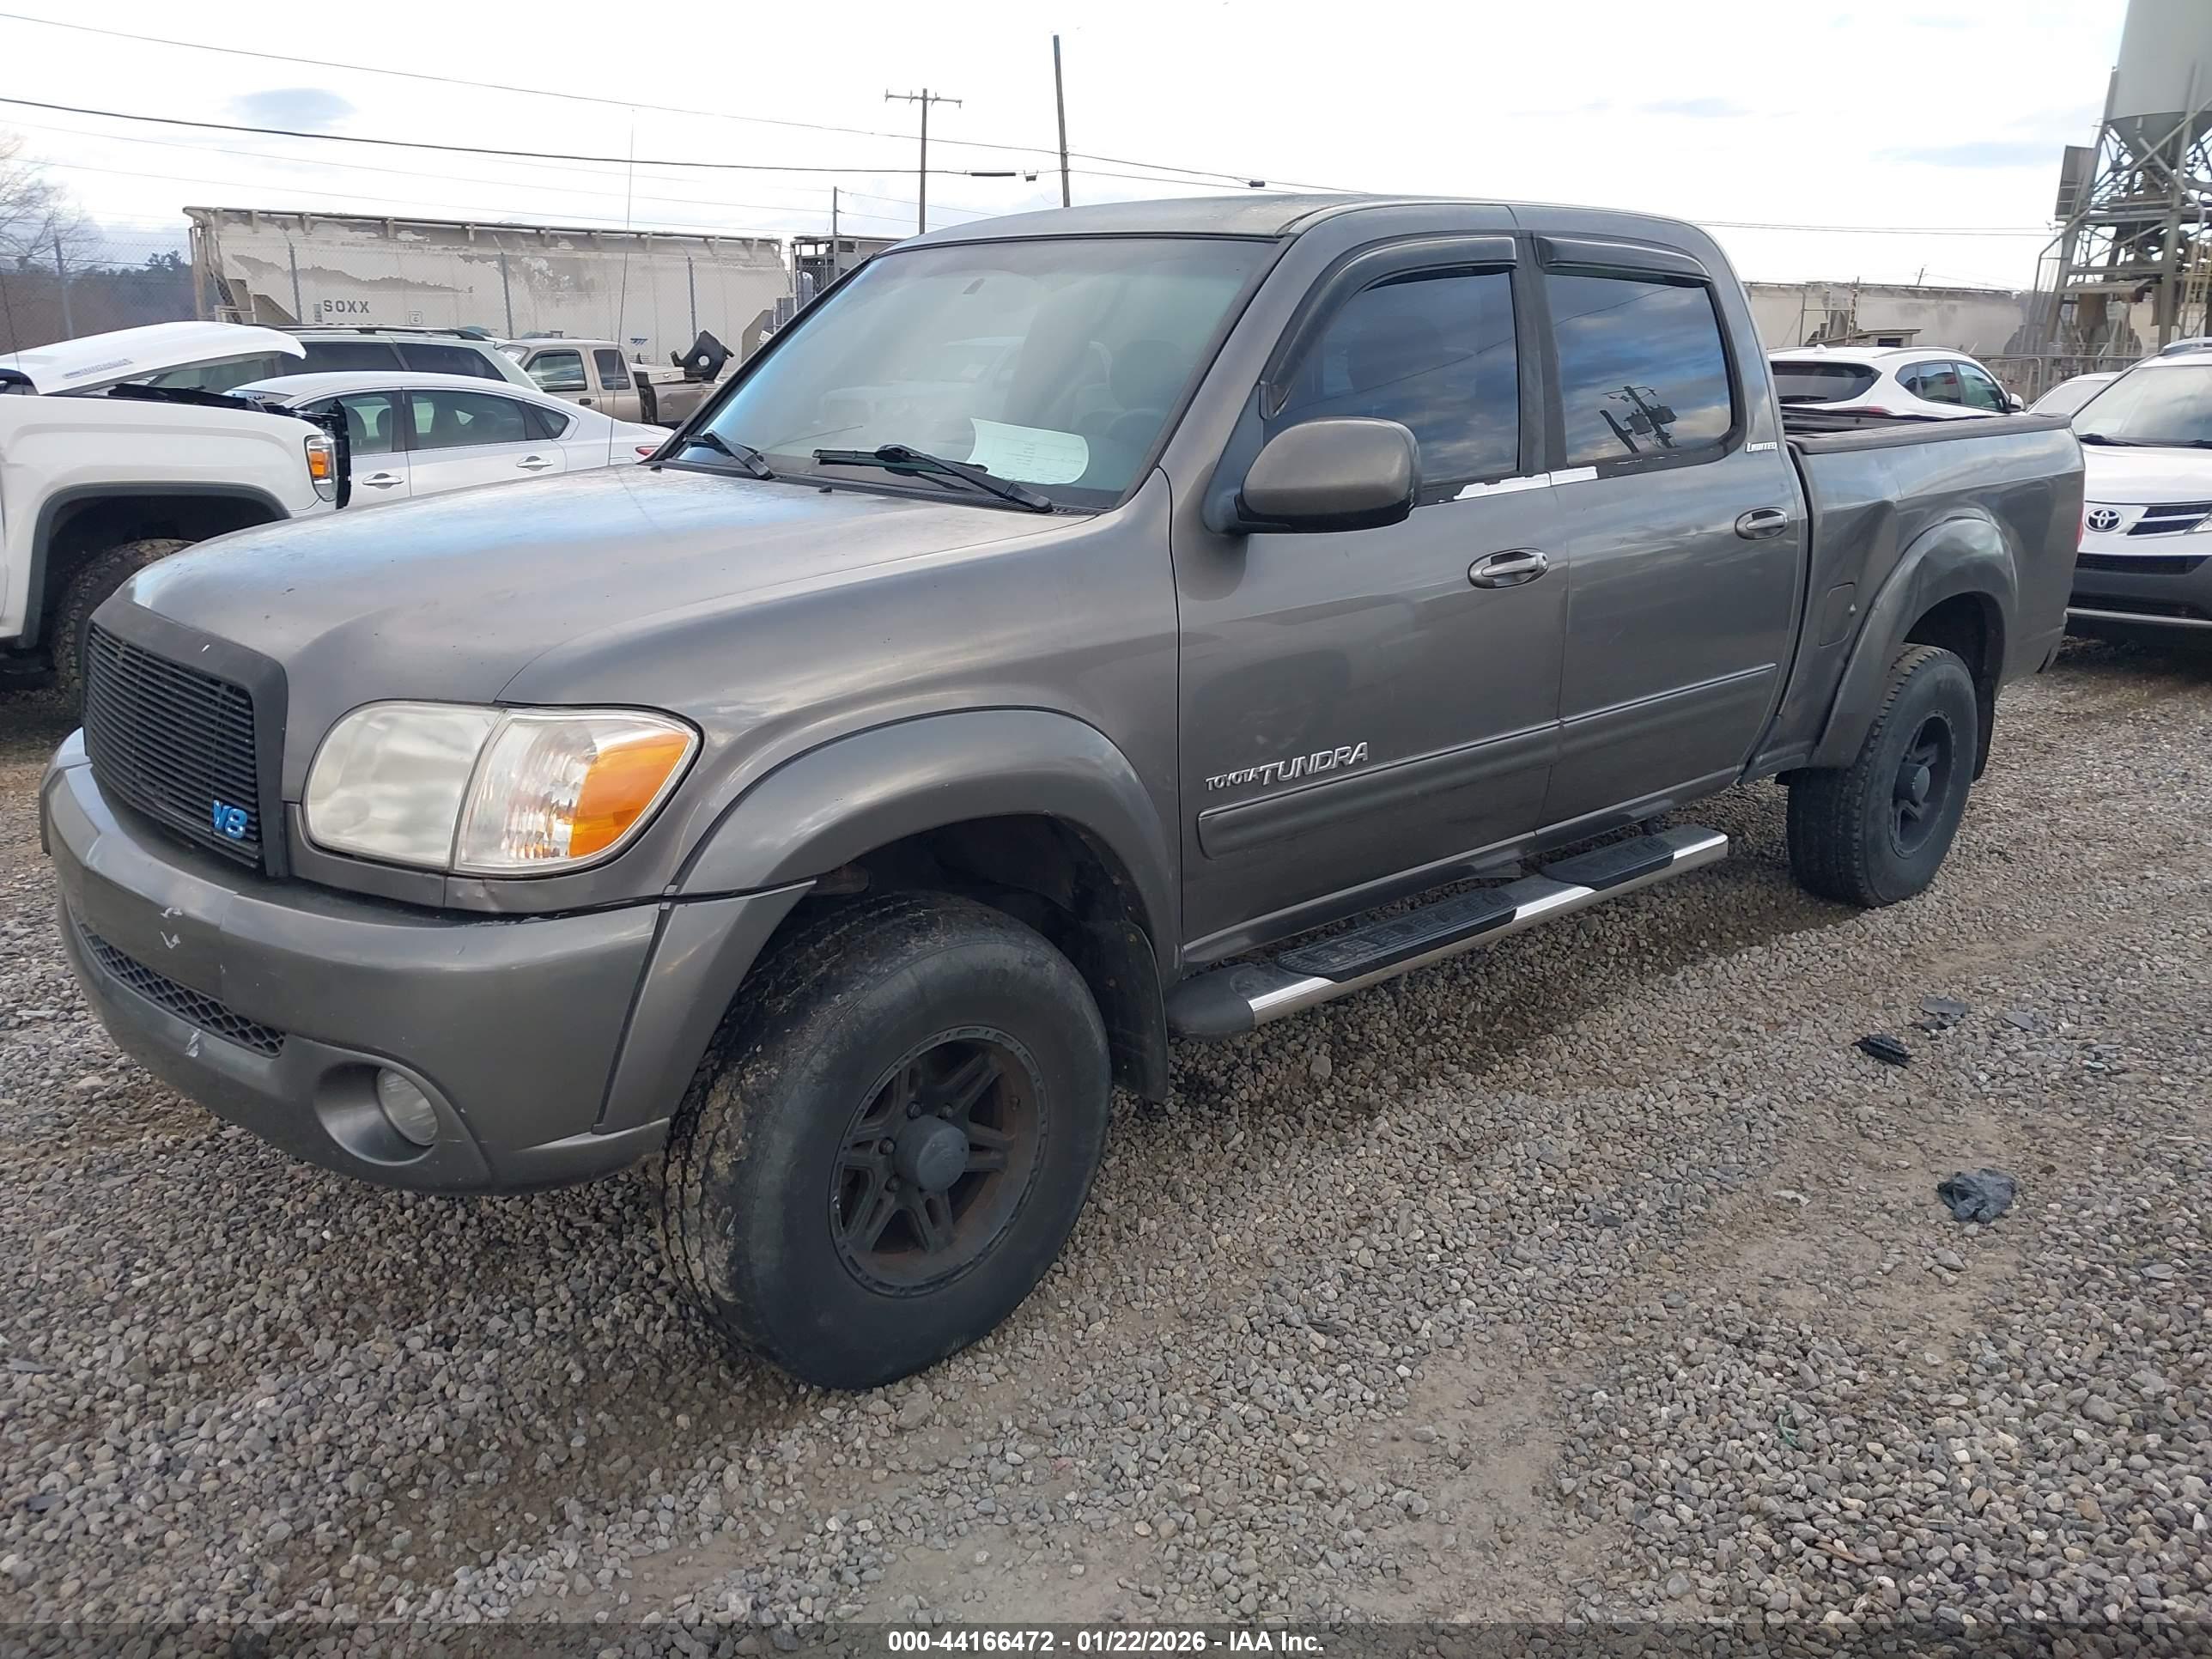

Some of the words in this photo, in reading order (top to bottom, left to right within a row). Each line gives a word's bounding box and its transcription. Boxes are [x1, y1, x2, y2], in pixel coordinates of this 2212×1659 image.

[323, 300, 370, 313] SOXX
[1205, 768, 1260, 791] TOYOTA
[1258, 741, 1369, 786] TUNDRA
[212, 799, 248, 839] V8
